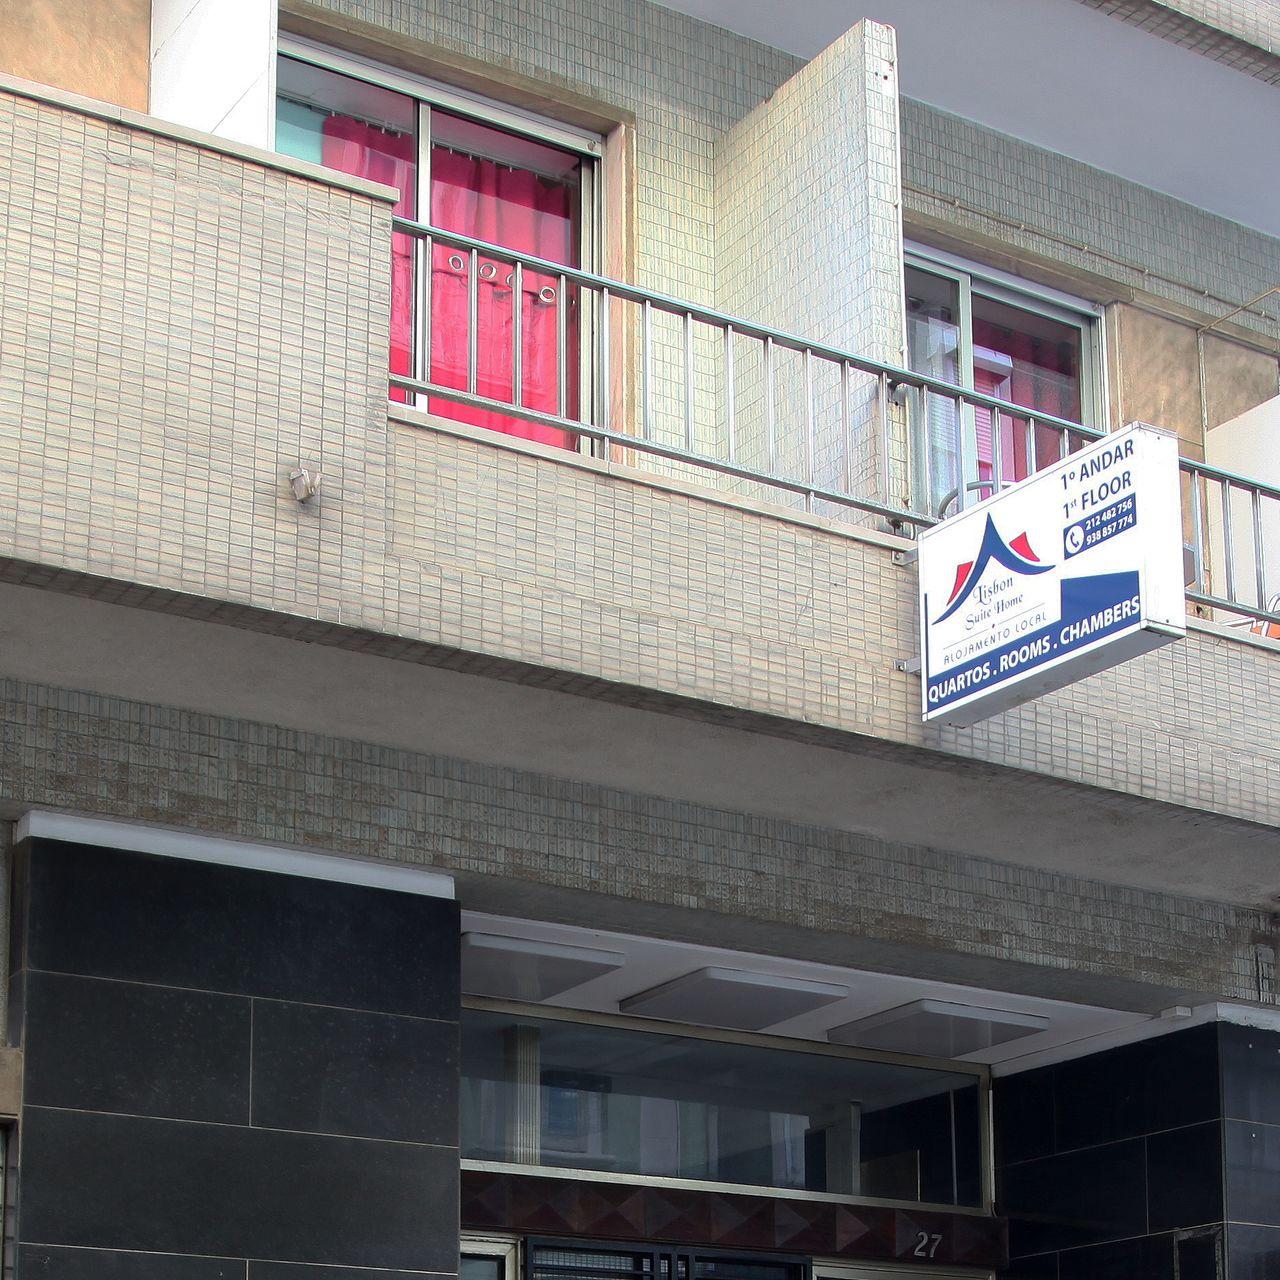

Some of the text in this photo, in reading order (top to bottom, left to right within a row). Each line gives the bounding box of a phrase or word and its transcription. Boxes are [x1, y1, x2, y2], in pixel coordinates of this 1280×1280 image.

[1079, 438, 1135, 483] ANDAR
[1081, 470, 1132, 511] FLOOR
[1085, 498, 1133, 531] 212 482 756
[1086, 513, 1134, 546] 938 857 774
[973, 577, 1014, 606] Lisbon
[965, 593, 1024, 631] Suite Home
[928, 595, 1141, 703] QUARTOS ROOMS CHAMBERS
[943, 611, 1048, 665] ALOJAMENTO LOCAL
[914, 1231, 943, 1258] 27
